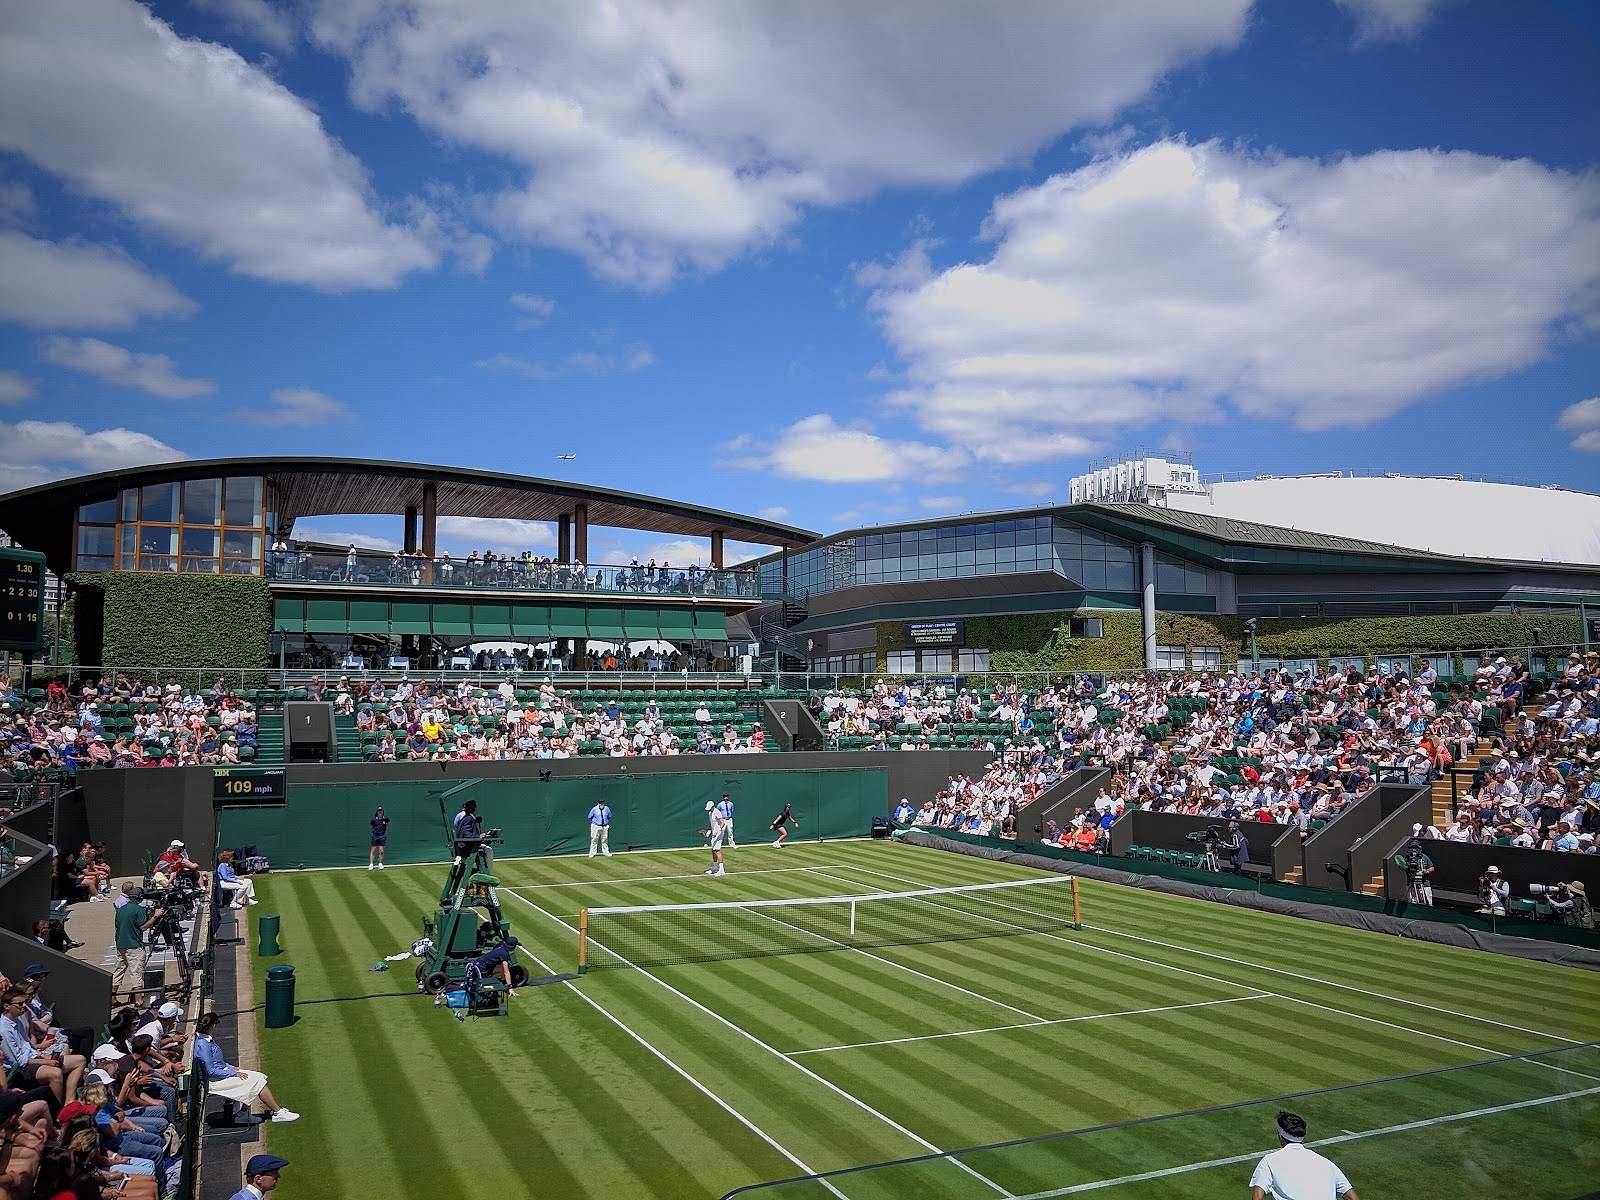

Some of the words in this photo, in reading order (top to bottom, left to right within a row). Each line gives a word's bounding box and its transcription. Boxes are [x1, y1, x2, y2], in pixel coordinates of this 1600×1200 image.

[16, 564, 33, 573] 1.30
[9, 587, 15, 596] 2
[18, 588, 24, 597] 2
[27, 589, 38, 597] 30
[7, 611, 14, 620] 0
[27, 613, 37, 621] 15
[305, 715, 310, 724] 1
[214, 769, 230, 777] IBM
[225, 780, 252, 793] 109
[254, 785, 273, 794] mph
